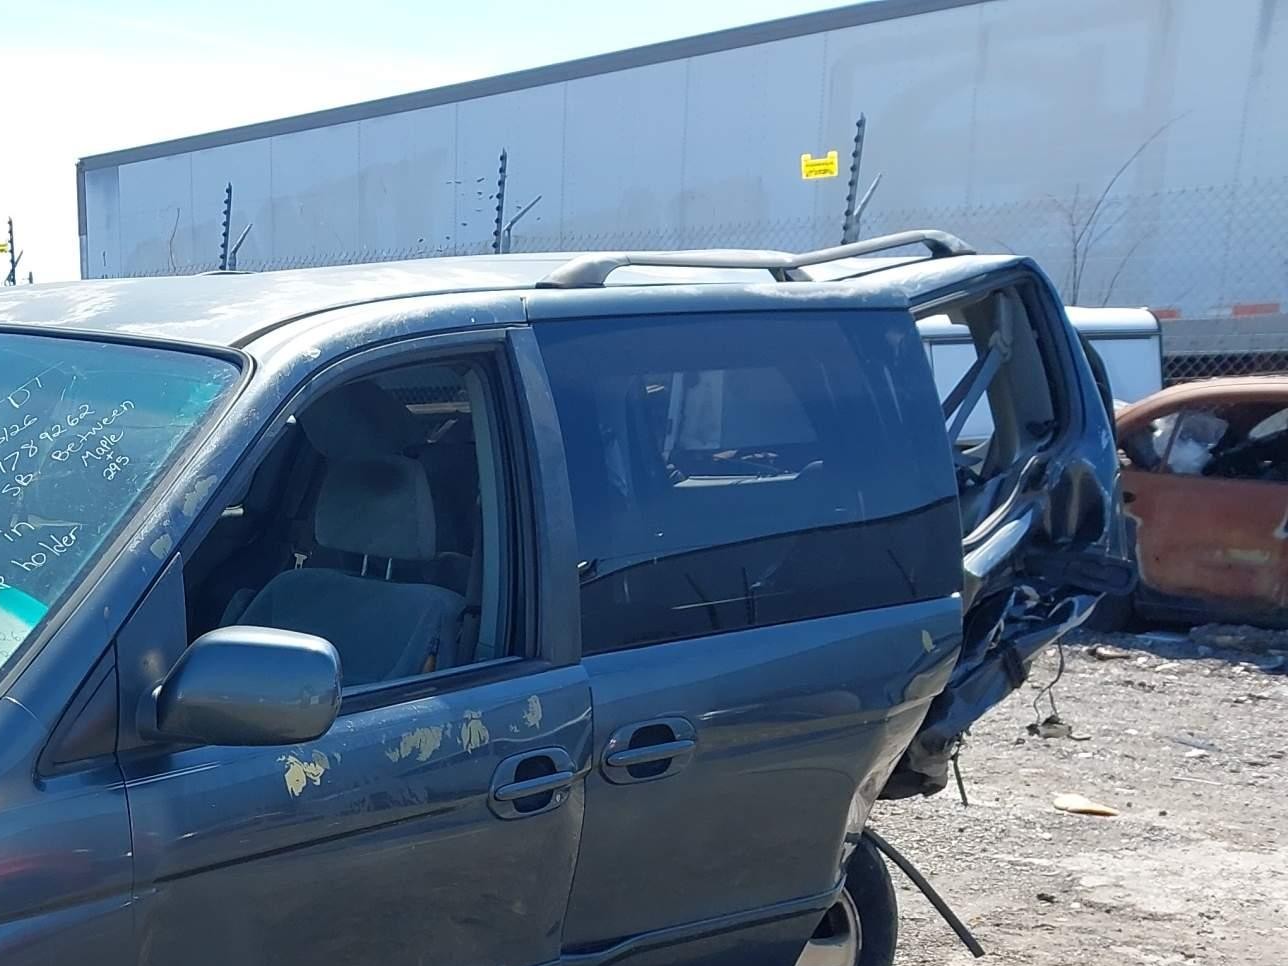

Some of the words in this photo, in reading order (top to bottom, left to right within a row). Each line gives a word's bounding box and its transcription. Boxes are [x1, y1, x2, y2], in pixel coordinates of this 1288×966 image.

[52, 399, 135, 462] Between
[0, 521, 36, 543] in
[11, 526, 79, 572] holder
